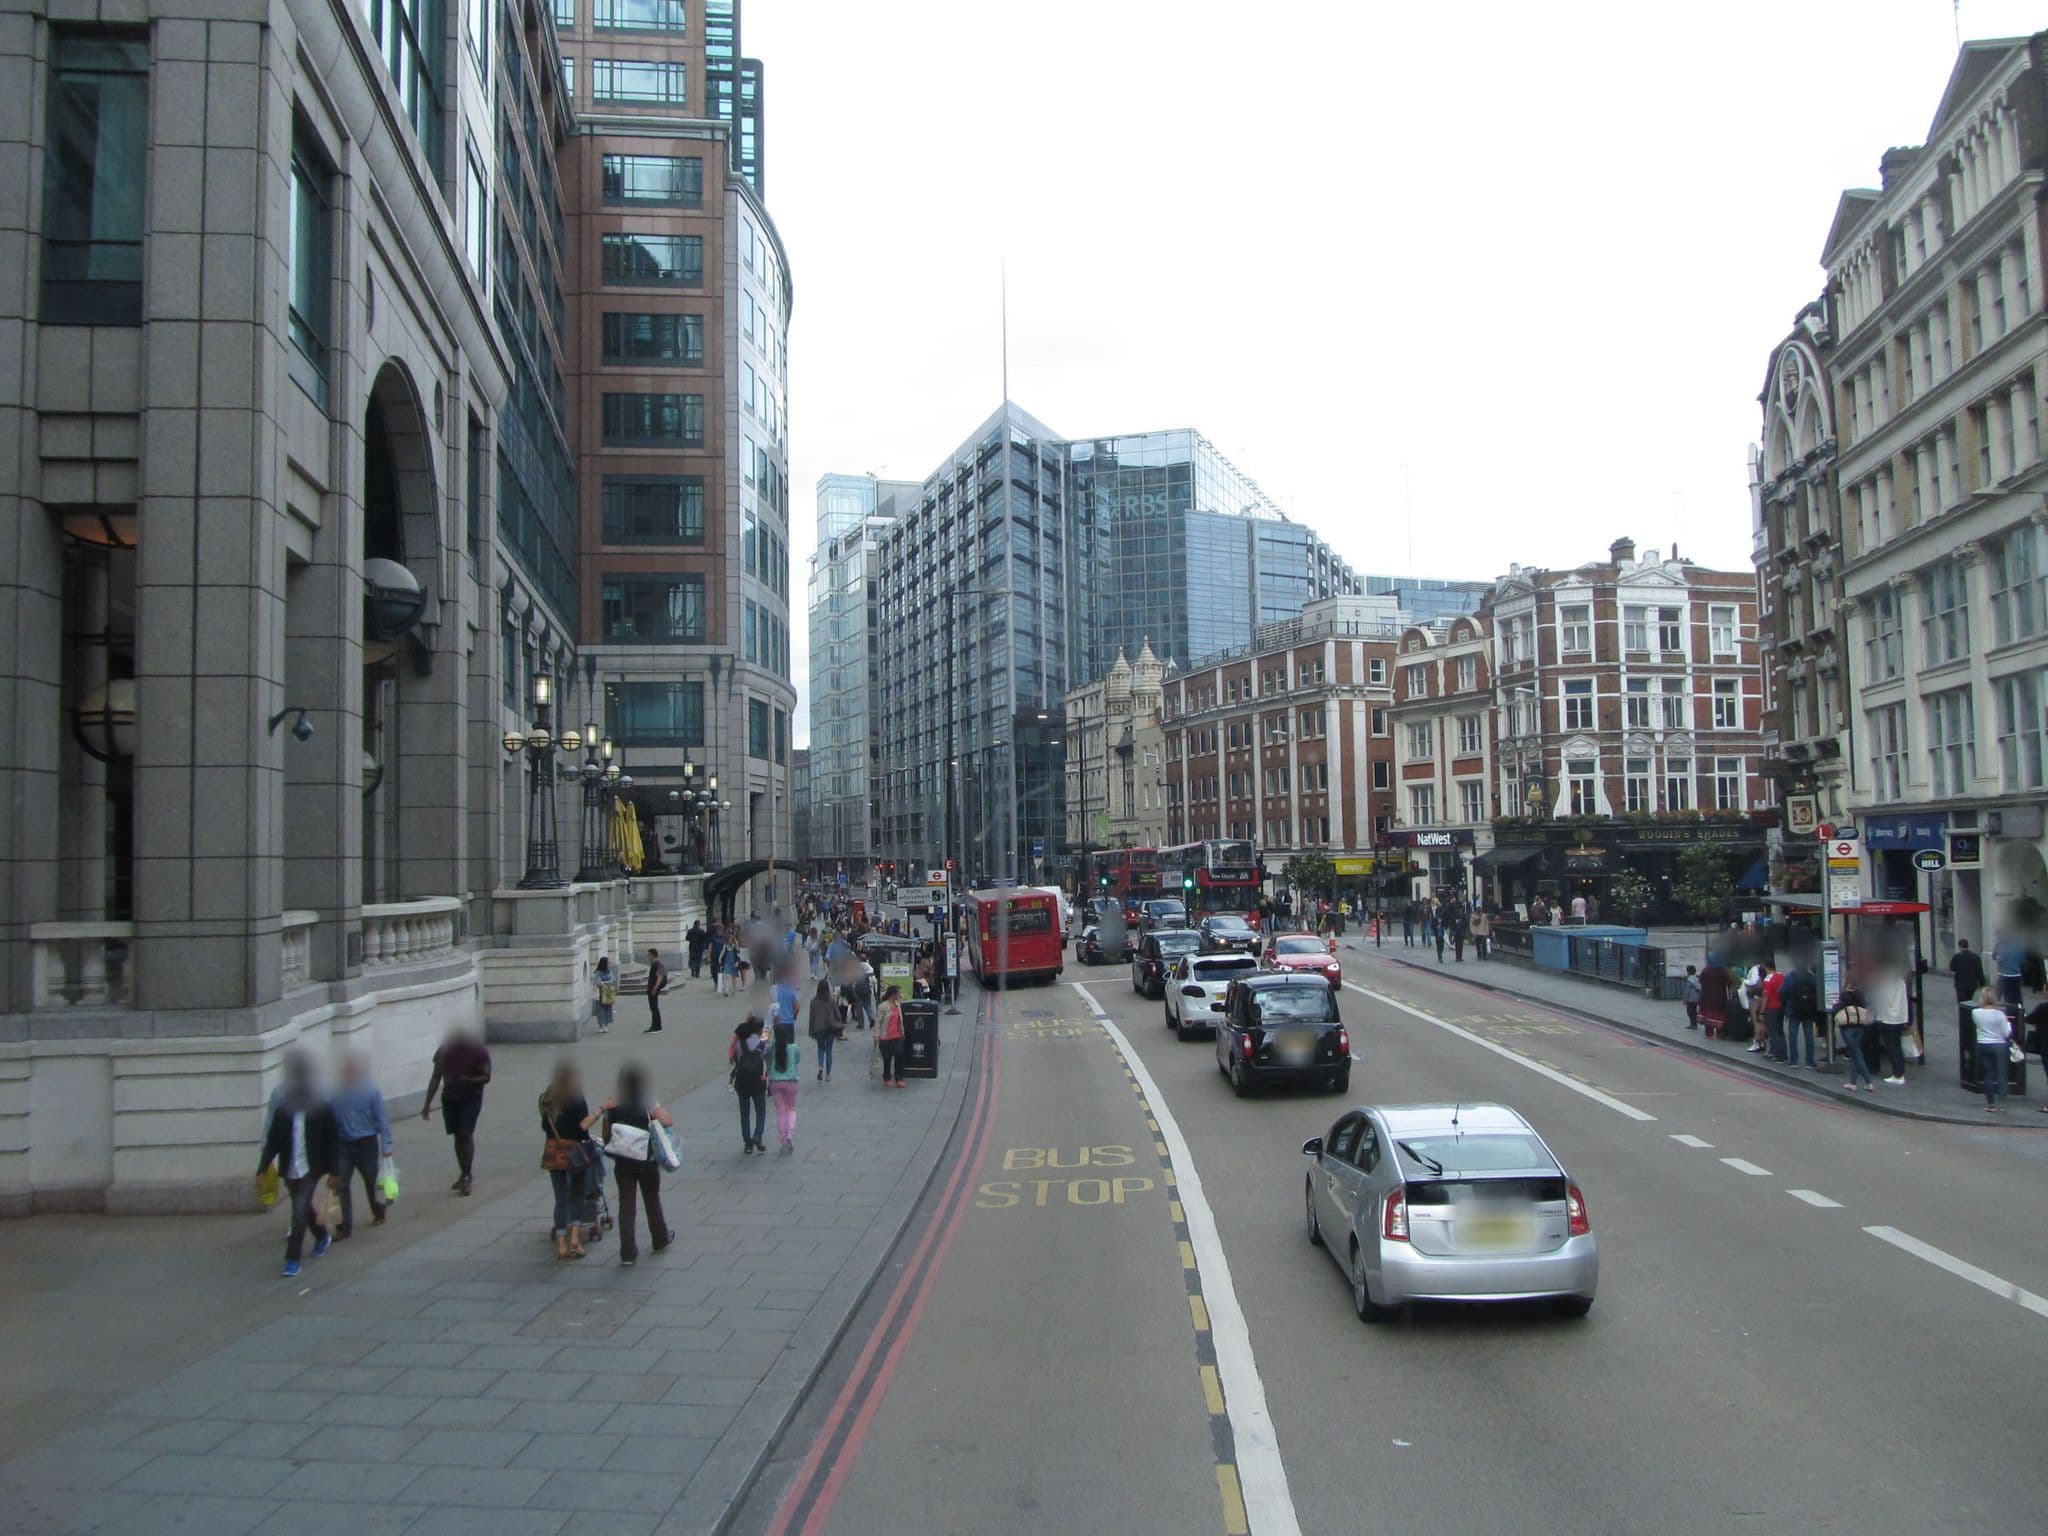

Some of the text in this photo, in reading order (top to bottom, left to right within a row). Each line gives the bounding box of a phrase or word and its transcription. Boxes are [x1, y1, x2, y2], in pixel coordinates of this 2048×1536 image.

[1416, 832, 1452, 846] NatWest
[1819, 827, 1828, 840] L
[1920, 859, 1941, 868] HILL
[1002, 1145, 1136, 1170] BUS
[975, 1177, 1155, 1209] STOP
